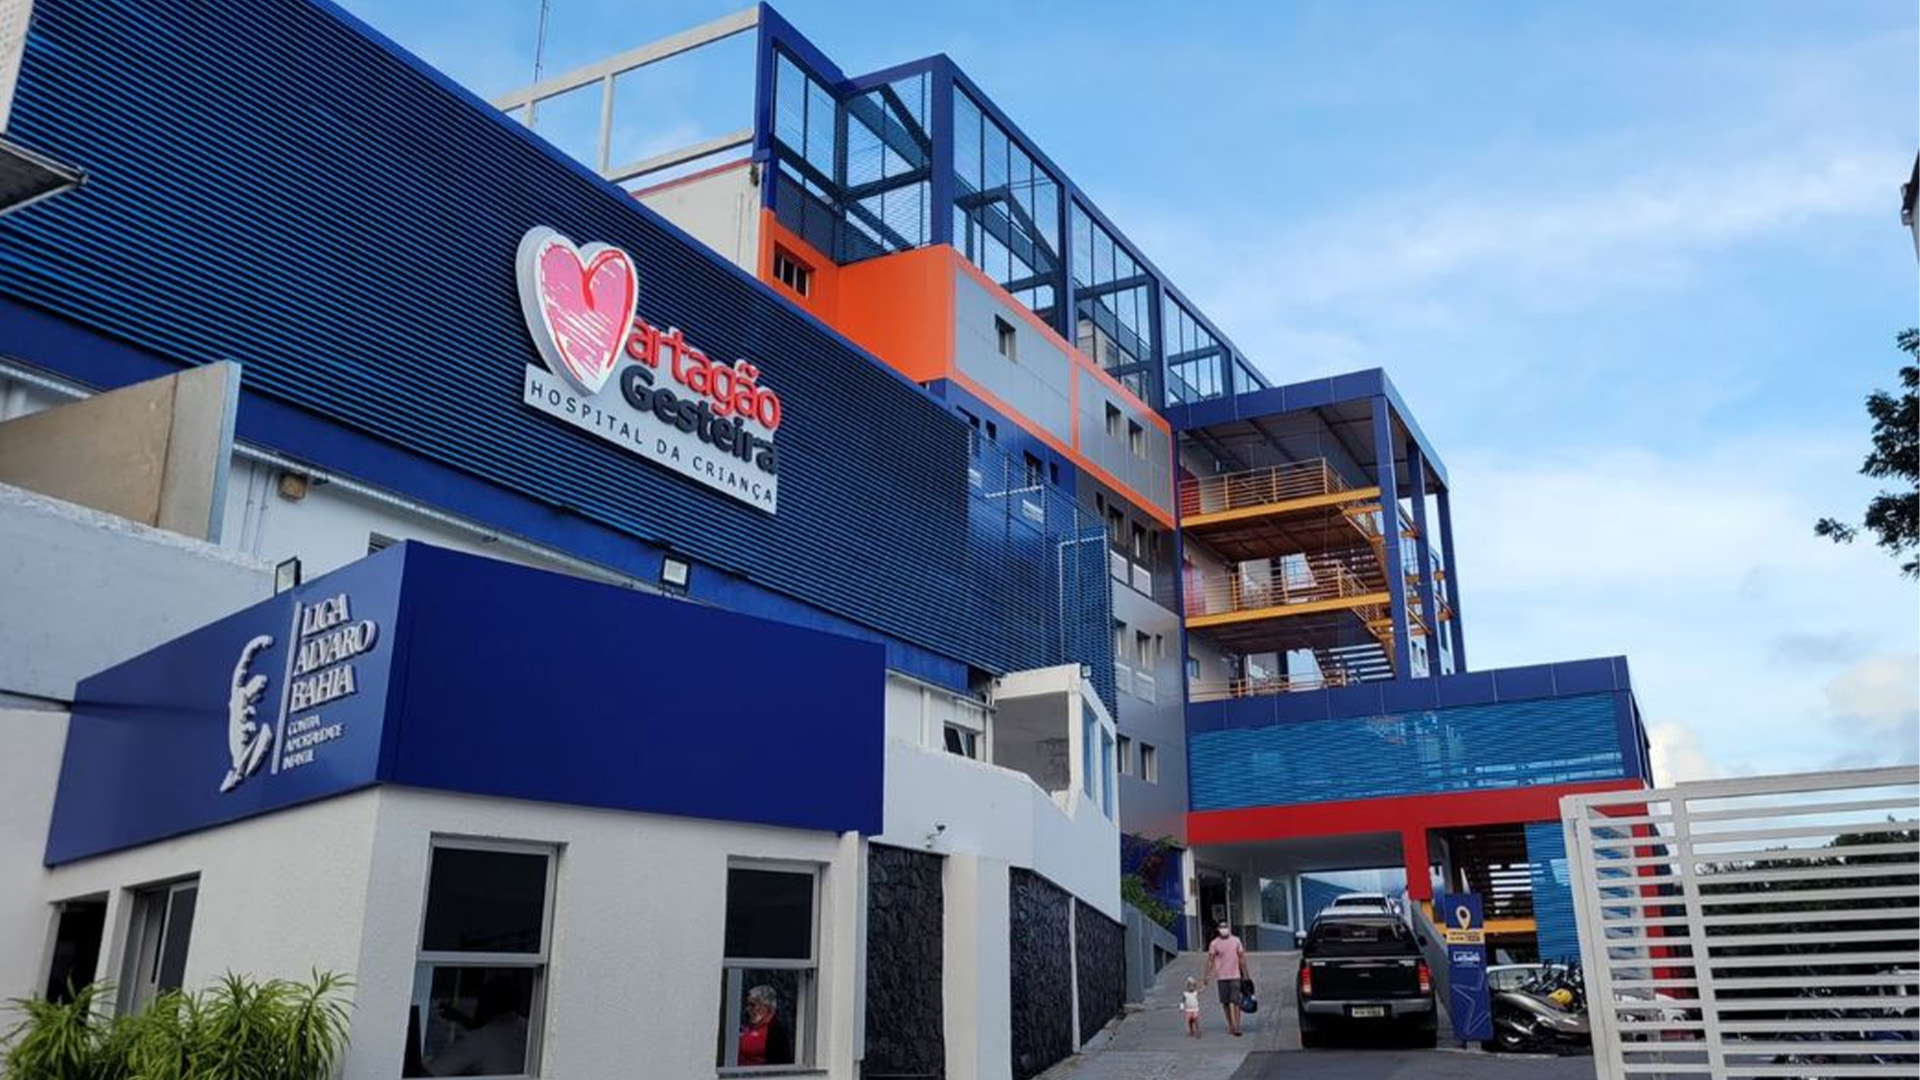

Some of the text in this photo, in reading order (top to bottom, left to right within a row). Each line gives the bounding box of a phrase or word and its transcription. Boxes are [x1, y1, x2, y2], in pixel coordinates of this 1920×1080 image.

[530, 379, 773, 503] HOSPITAL DA CRIANÇA
[620, 364, 778, 475] Gesteira
[302, 593, 351, 637] LIGA
[289, 663, 356, 714] BAHIA
